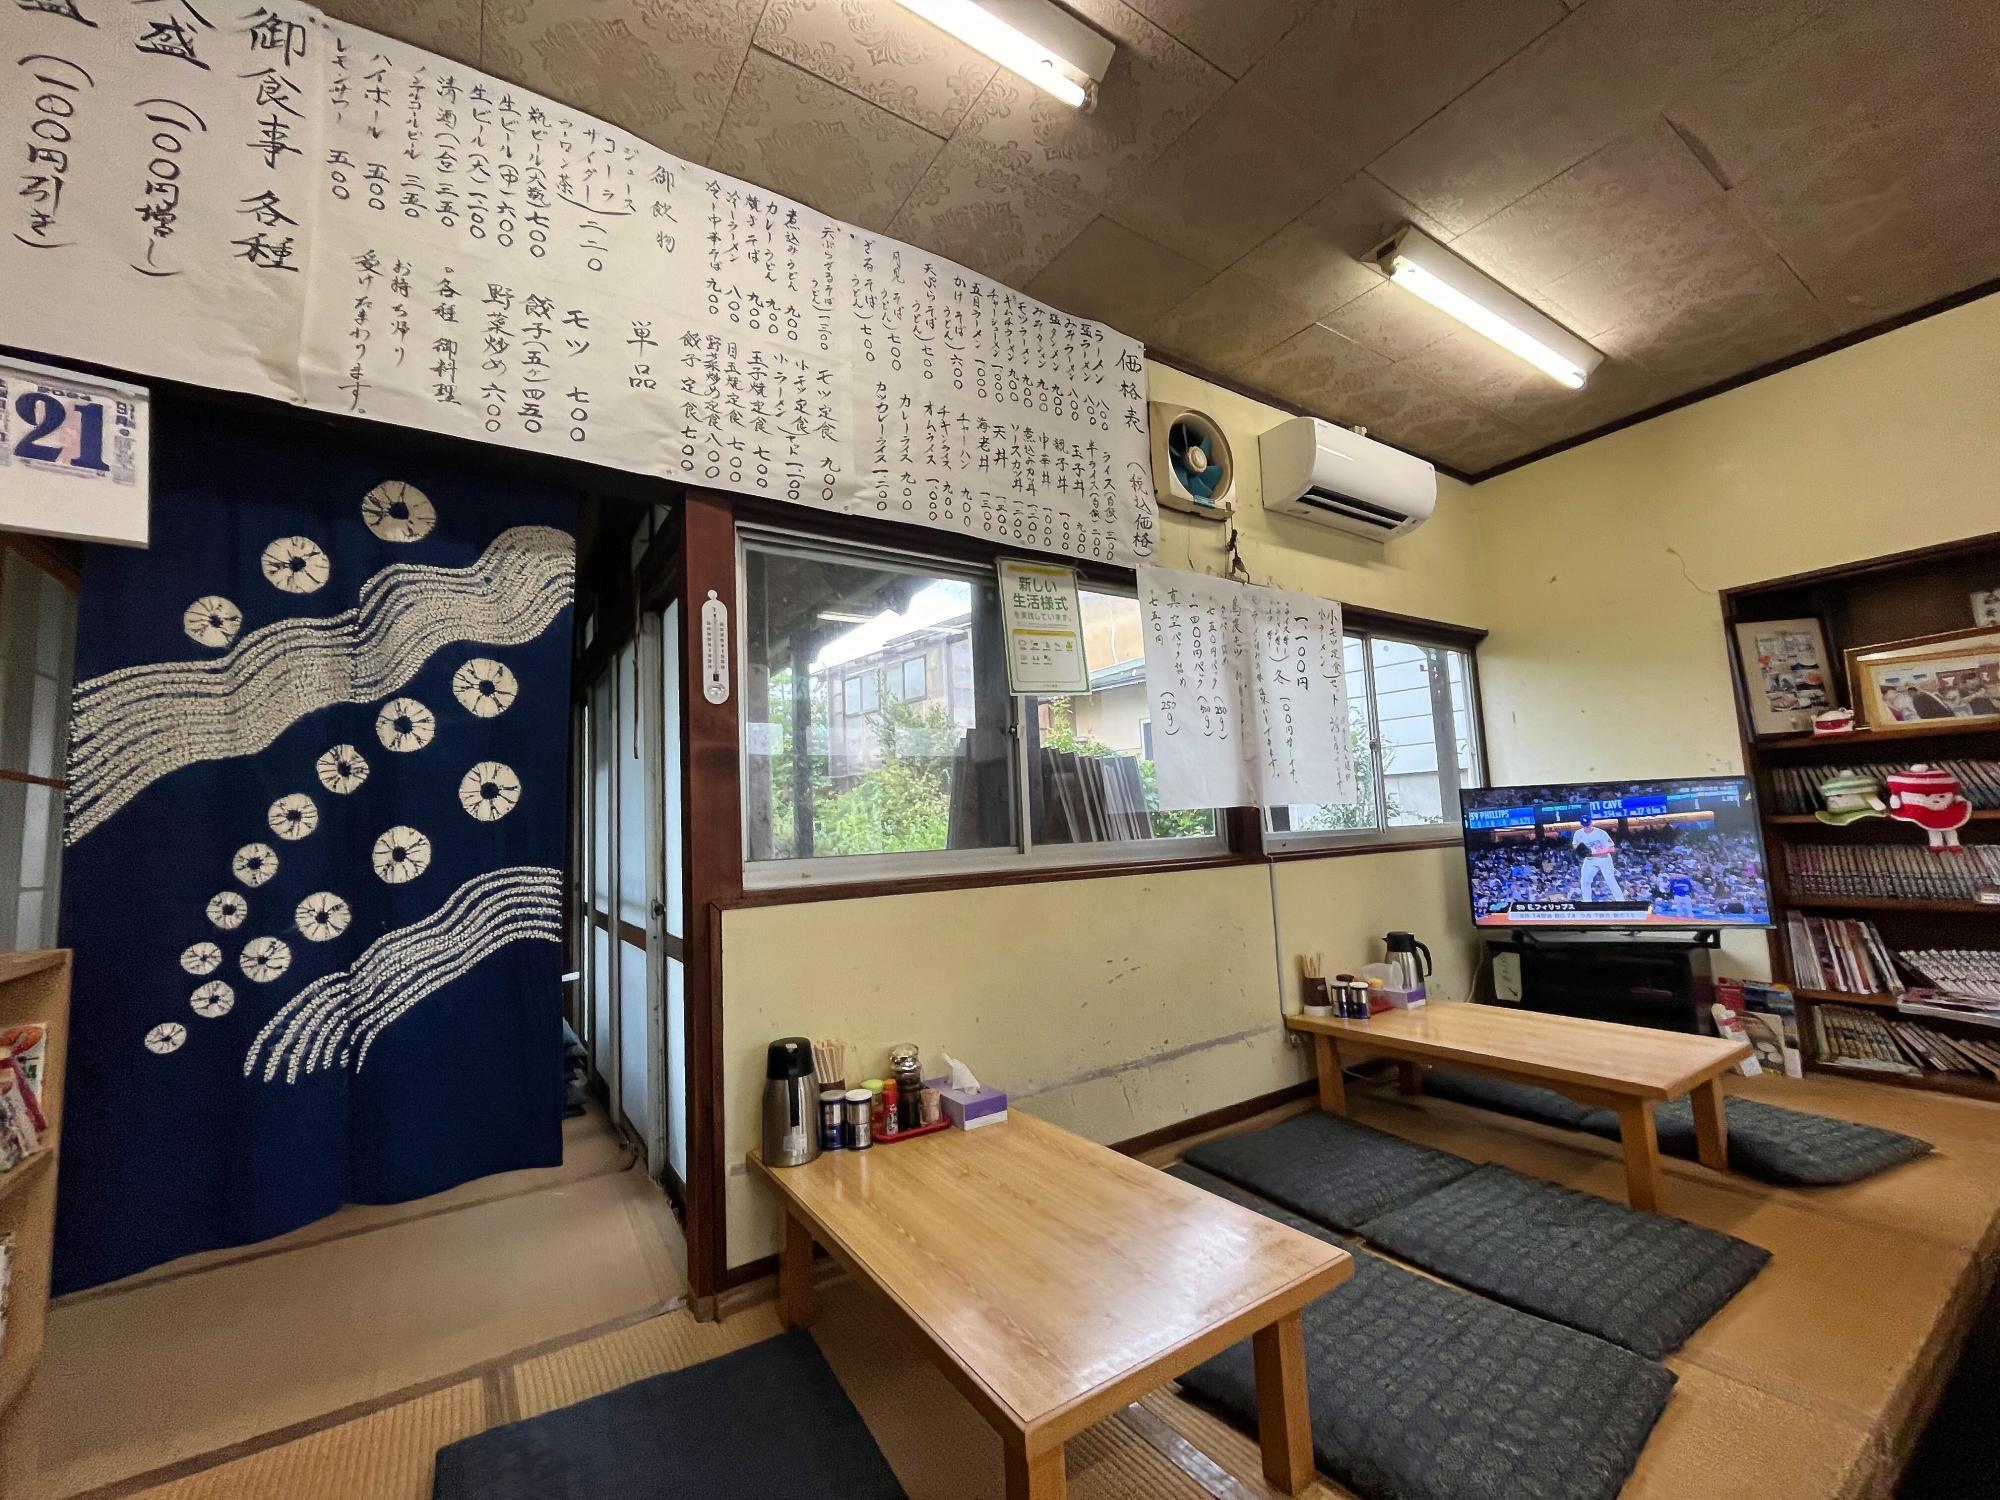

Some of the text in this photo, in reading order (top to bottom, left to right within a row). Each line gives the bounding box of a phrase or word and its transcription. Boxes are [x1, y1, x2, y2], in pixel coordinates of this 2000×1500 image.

[231, 8, 305, 272] 御食事 各種
[562, 310, 590, 357] モツ
[626, 320, 659, 390] 単品
[1092, 329, 1105, 385] ラーメン
[1115, 349, 1146, 434] 価格表
[13, 392, 110, 472] 21
[993, 425, 1008, 468] 天丼
[1013, 593, 1069, 611] 生活様式
[1018, 576, 1057, 592] 新しい
[1480, 810, 1510, 820] PHILLIPS
[1602, 799, 1623, 810] CAVE
